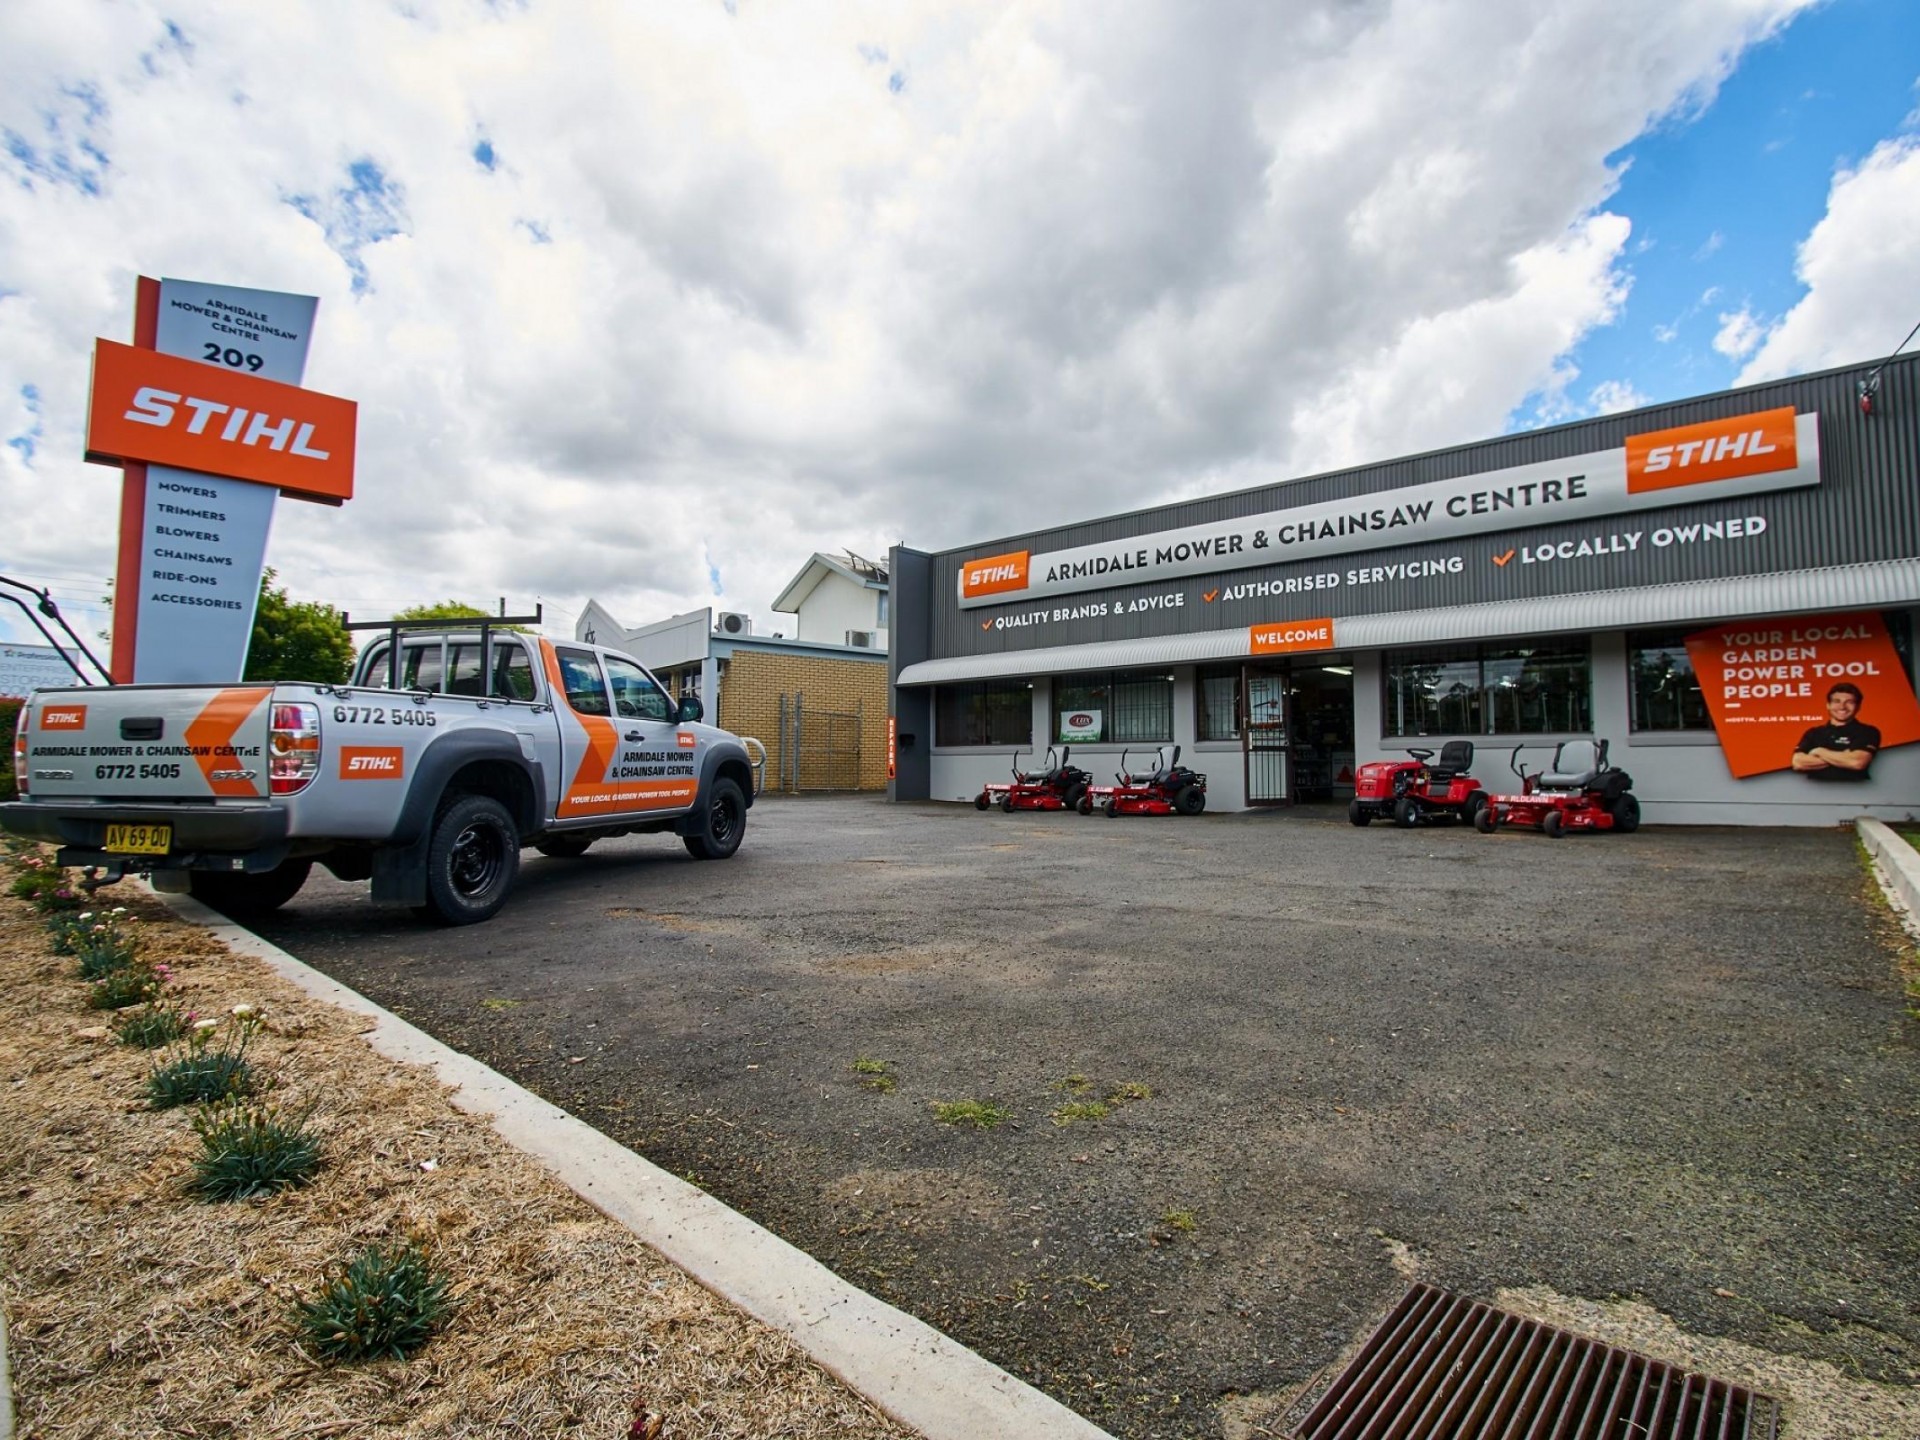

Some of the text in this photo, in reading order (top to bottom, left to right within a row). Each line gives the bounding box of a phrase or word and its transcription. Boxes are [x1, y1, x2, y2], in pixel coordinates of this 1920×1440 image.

[206, 299, 268, 322] ARMIDALE
[171, 300, 298, 341] MOWER & CHAINSAW
[211, 322, 260, 341] CENTRE
[202, 342, 264, 372] 209
[123, 386, 331, 461] STIHL
[1643, 429, 1776, 473] STIHL
[158, 482, 218, 499] MOWERS
[157, 503, 226, 521] TRIMMERS
[155, 525, 220, 542] BLOWERS
[1046, 474, 1587, 583] ARMIDALE MOWER & CHAINSAW CENTRE
[1521, 516, 1767, 564] LOCALLY OWNED
[154, 548, 233, 566] CHAINSAWS
[152, 570, 217, 586] RIDE-ONS
[969, 563, 1020, 586] STIHL
[1222, 556, 1464, 601] AUTHORISED SERVICING
[151, 593, 242, 610] ACCESSORIES
[995, 593, 1185, 631] QUALITY BRANDS & ADVICE
[1255, 628, 1328, 645] WELCOME
[1721, 624, 1872, 647] YOUR LOCAL
[1722, 646, 1816, 664] GARDEN
[1723, 661, 1880, 682] POWER TOOL
[1724, 682, 1812, 699] PEOPLE
[46, 712, 80, 724] STIHL
[333, 705, 437, 727] 6772 5405
[32, 746, 87, 756] ARMIDALE
[90, 746, 133, 756] MOWER
[135, 746, 144, 756] &
[146, 746, 211, 756] CHAINSAW
[623, 751, 694, 763] ARMIDALE MOWER
[96, 764, 180, 779] 6772 5405
[348, 756, 395, 770] STIHL
[611, 765, 694, 778] & CHAINSAW CENTRE
[571, 788, 690, 804] YOUR LOCAL GARDEN POWER TOOL PEOPLE
